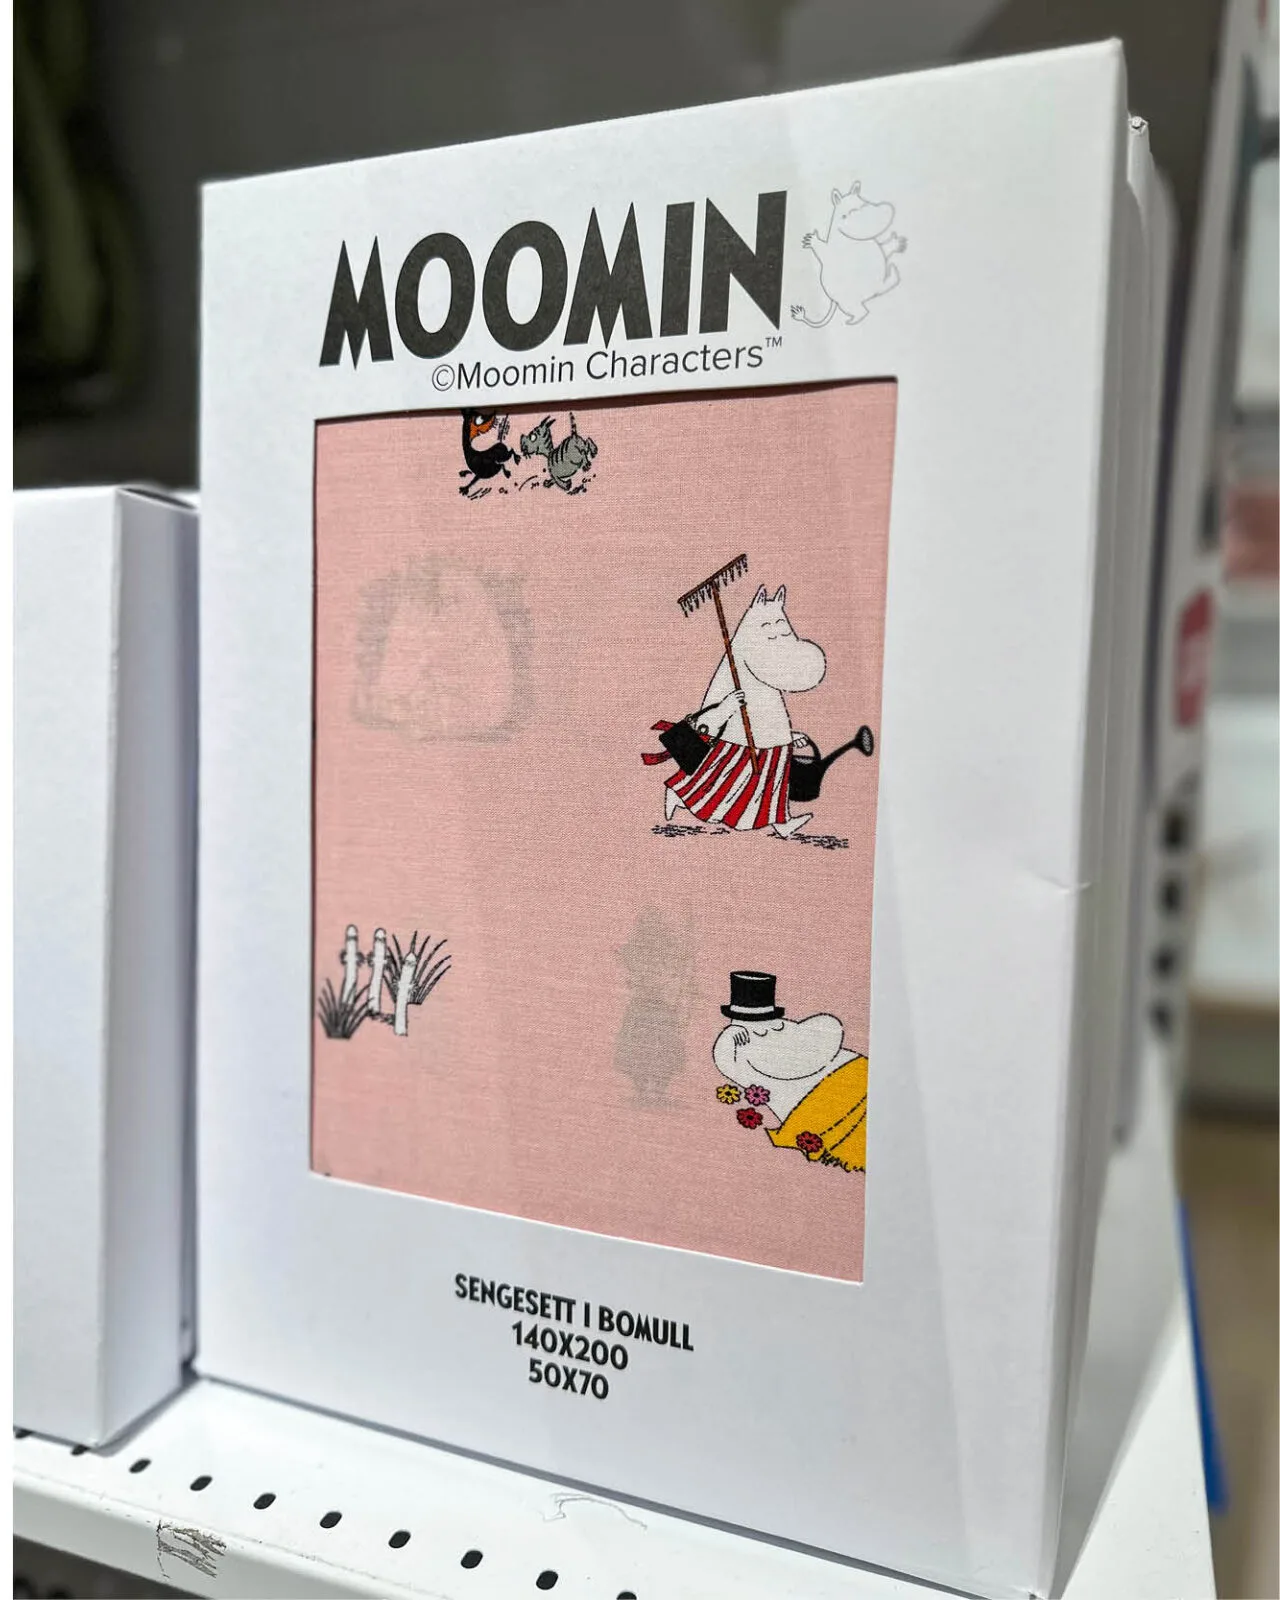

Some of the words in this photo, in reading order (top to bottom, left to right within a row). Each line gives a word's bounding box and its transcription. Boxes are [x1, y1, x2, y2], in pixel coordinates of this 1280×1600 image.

[319, 190, 788, 370] MOOMIN
[455, 1272, 577, 1325] SENGESETT
[583, 1301, 591, 1329] I
[598, 1305, 695, 1352] BOMULL
[512, 1320, 629, 1371] 140X200
[528, 1357, 610, 1401] 50X70
